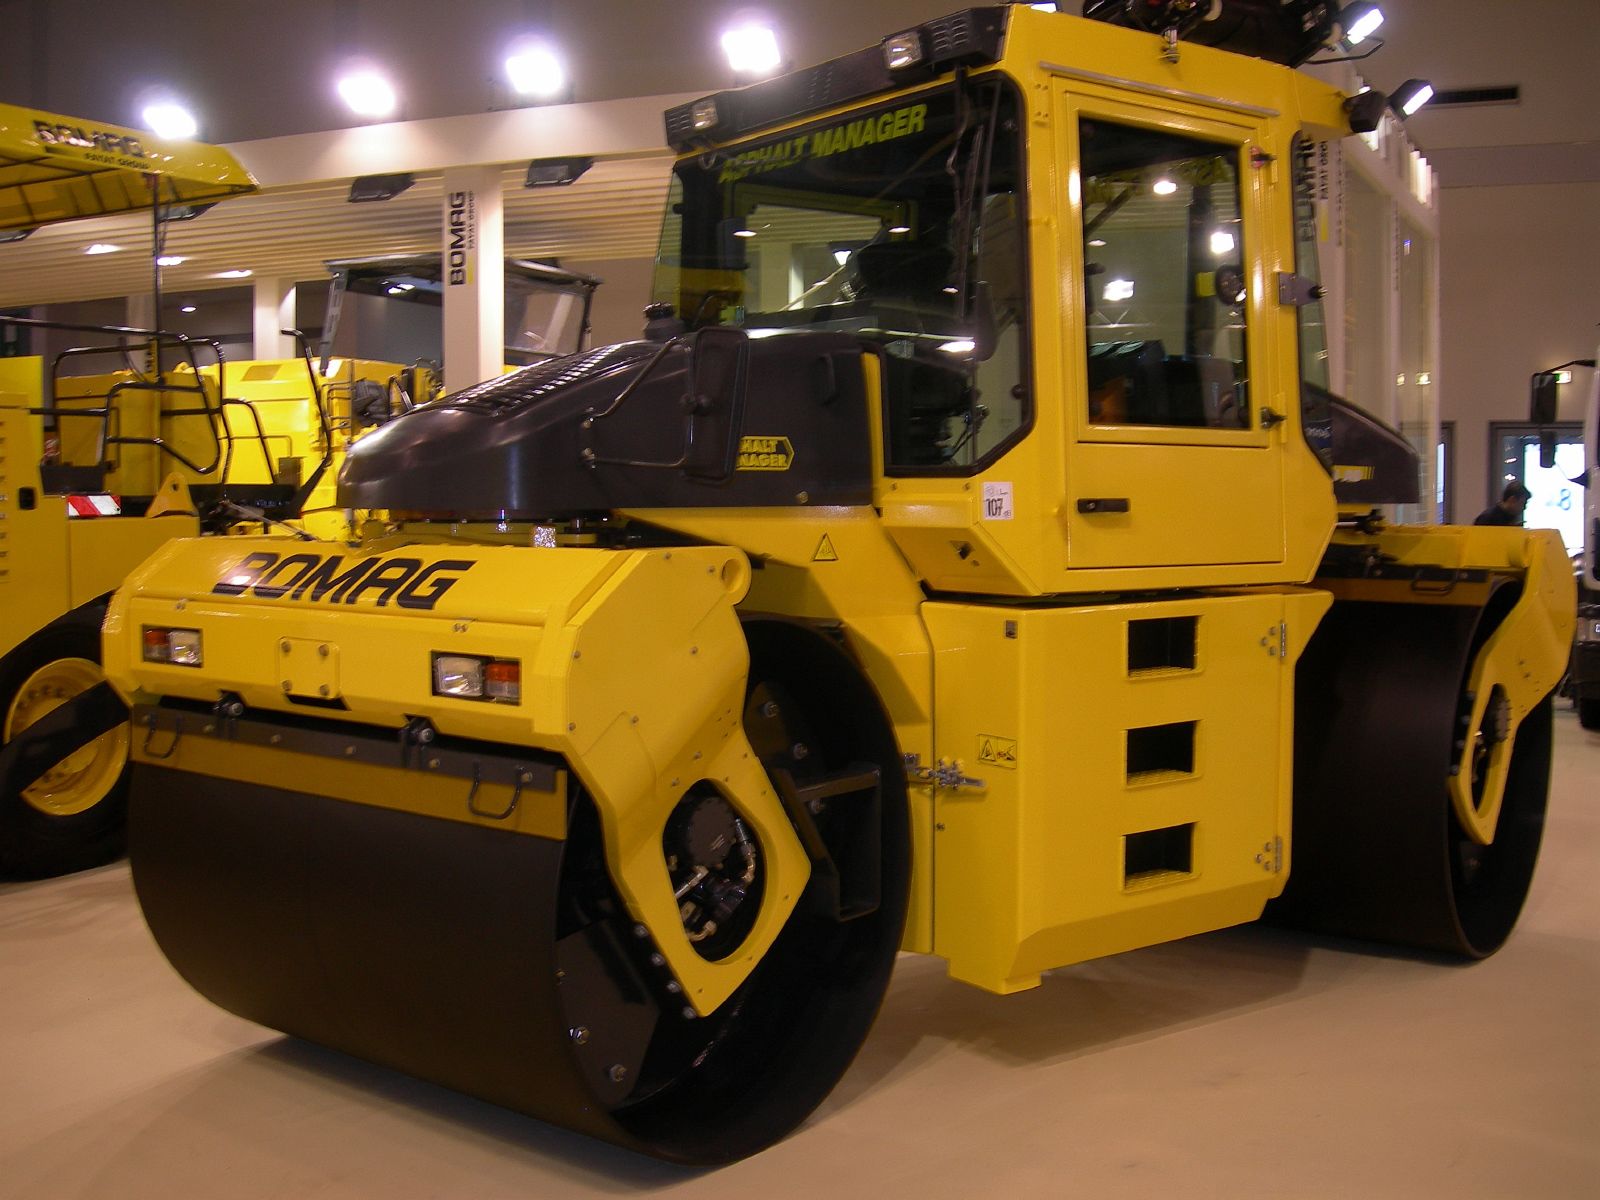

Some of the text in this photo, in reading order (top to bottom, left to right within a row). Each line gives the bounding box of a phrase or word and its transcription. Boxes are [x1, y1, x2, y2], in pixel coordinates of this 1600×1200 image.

[718, 104, 927, 184] ASPHALT MANAGER
[1320, 141, 1328, 165] GRO
[449, 191, 466, 286] BOMAG
[986, 498, 1003, 516] 107
[212, 552, 478, 610] BOMAG
